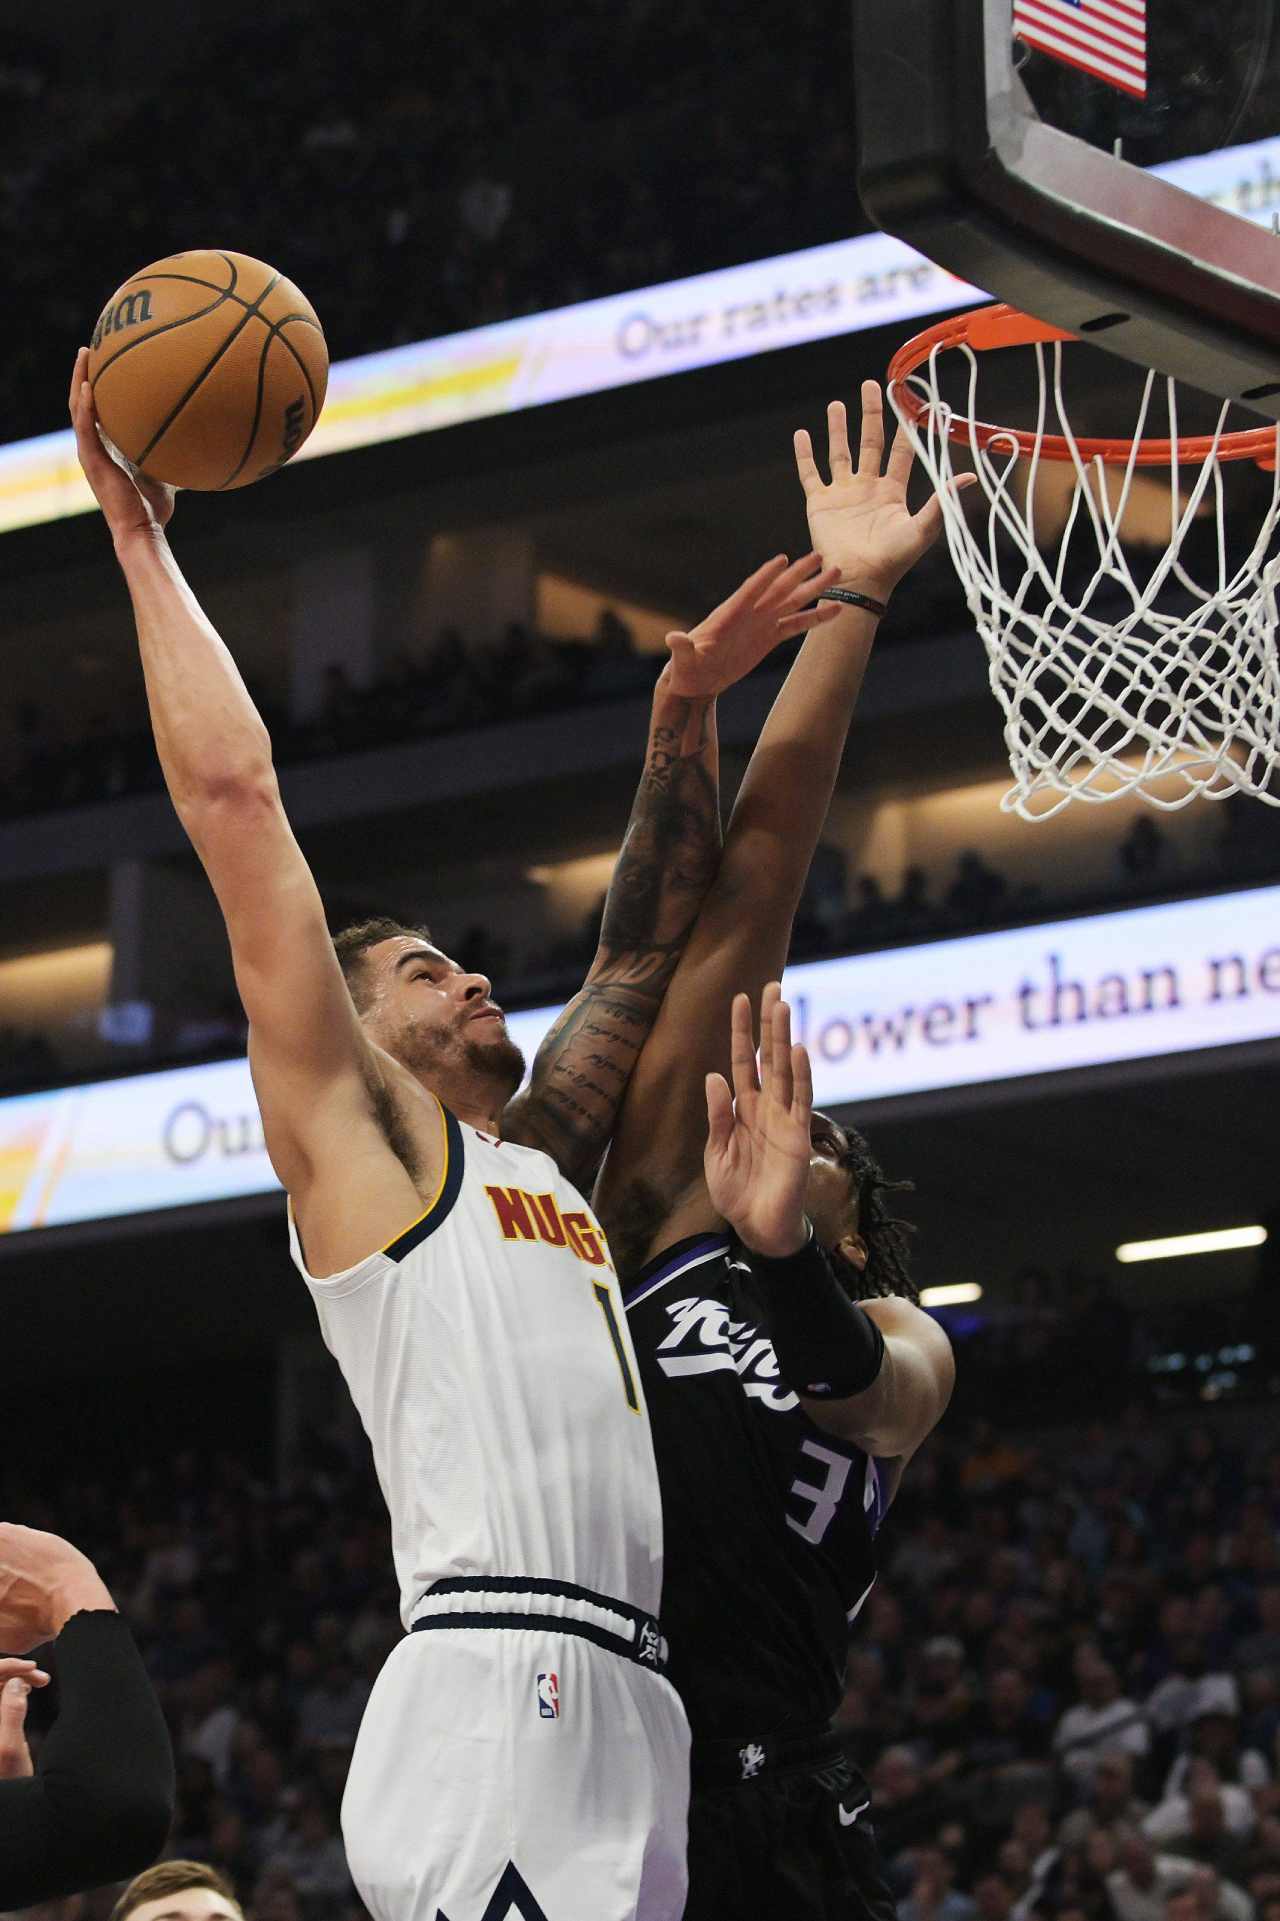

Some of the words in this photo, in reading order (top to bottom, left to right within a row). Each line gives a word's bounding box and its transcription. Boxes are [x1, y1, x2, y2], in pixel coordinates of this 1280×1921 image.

[616, 313, 712, 358] Our
[722, 283, 841, 333] rates
[855, 265, 932, 300] are
[162, 1100, 266, 1167] Ou
[793, 994, 992, 1063] lower
[1015, 953, 1182, 1031] than
[484, 1184, 614, 1272] NUG
[592, 1279, 641, 1415] 1
[785, 1439, 852, 1545] 3
